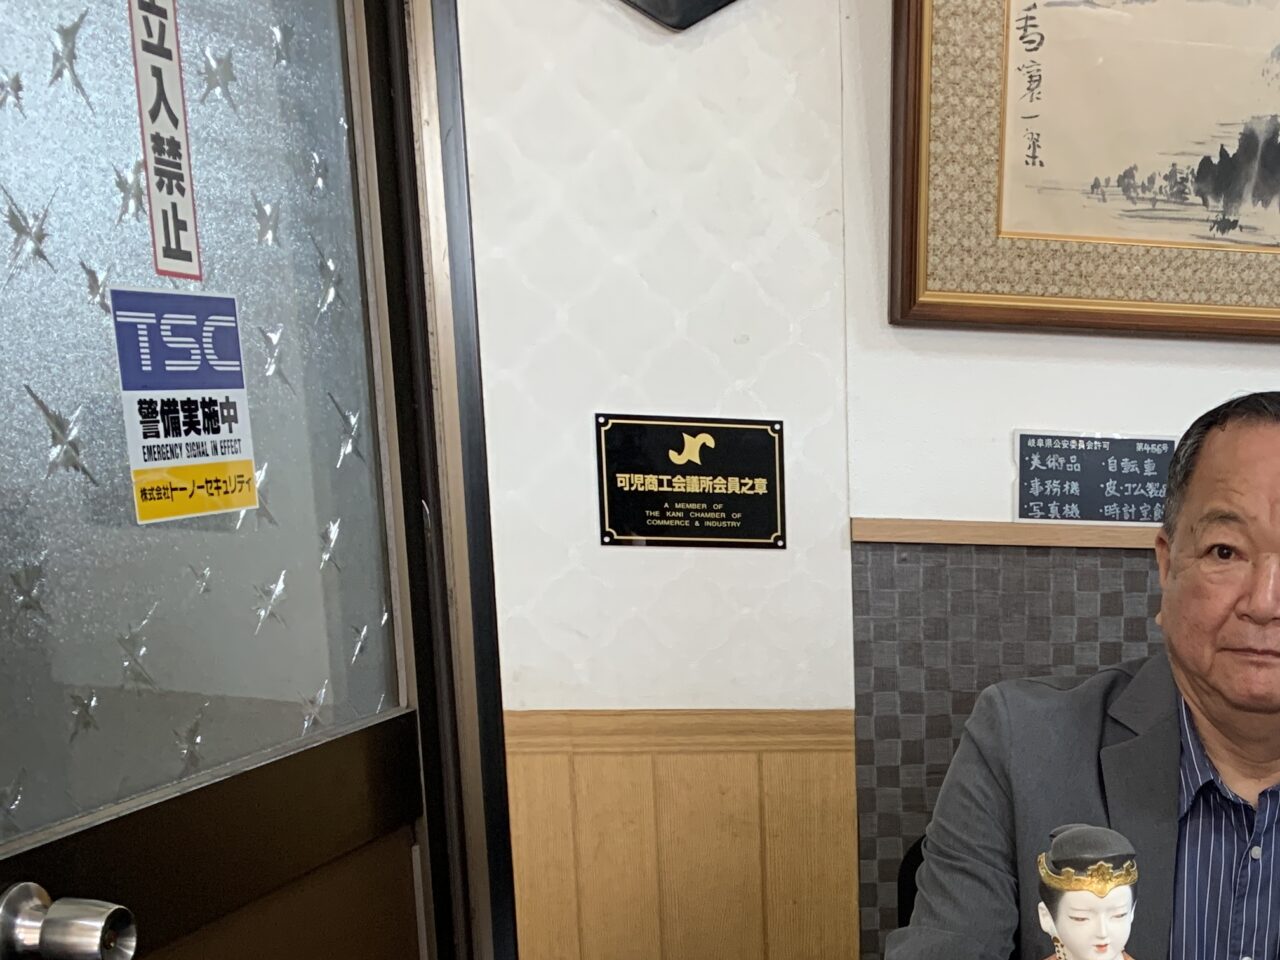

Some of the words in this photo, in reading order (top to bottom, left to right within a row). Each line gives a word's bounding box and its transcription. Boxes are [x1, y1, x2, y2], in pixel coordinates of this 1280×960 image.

[138, 0, 193, 263] 立入禁止
[116, 310, 241, 372] TSC
[137, 395, 239, 440] 警備実施中
[142, 443, 183, 463] EMERGENCY
[186, 439, 210, 459] SIGNAL
[211, 440, 219, 456] IN
[220, 438, 242, 456] EFFECT
[139, 474, 253, 503] 株式会社トーノーセキュリティ
[615, 473, 768, 495] 可児商工会議所会員之章
[645, 510, 661, 518] THE
[689, 511, 726, 519] CHAMBER
[646, 519, 690, 527] COMMERCE
[704, 520, 742, 528] INDUSTRY
